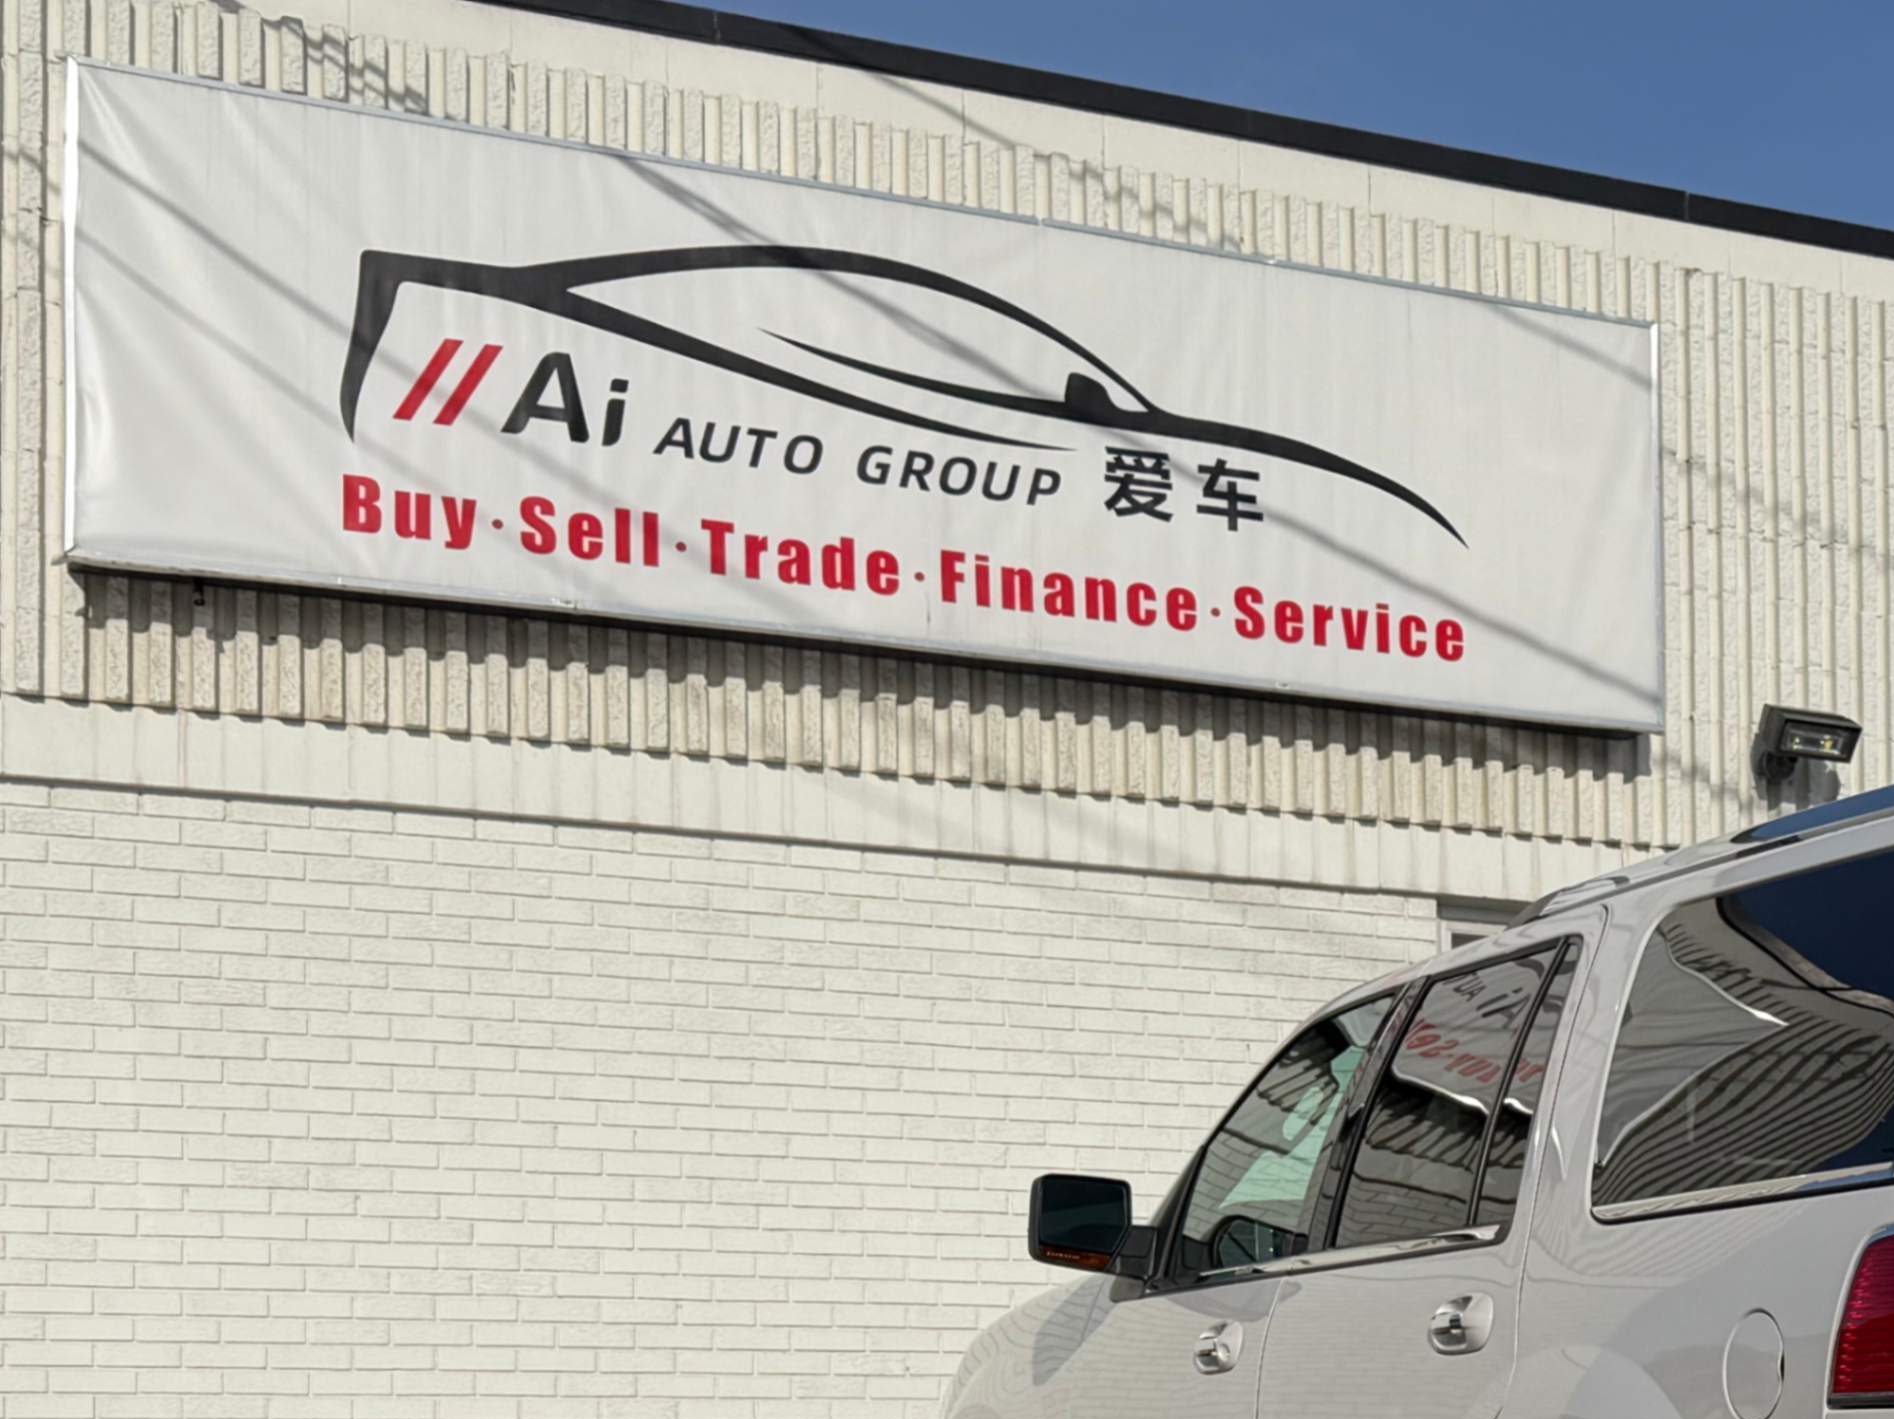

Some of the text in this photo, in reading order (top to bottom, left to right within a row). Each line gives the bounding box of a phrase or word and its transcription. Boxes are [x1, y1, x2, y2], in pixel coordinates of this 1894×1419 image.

[502, 353, 1061, 505] Ai AUTO GROUP
[1104, 447, 1264, 531] 爱车
[343, 475, 1464, 662] Buy Sell Trade Finance Service
